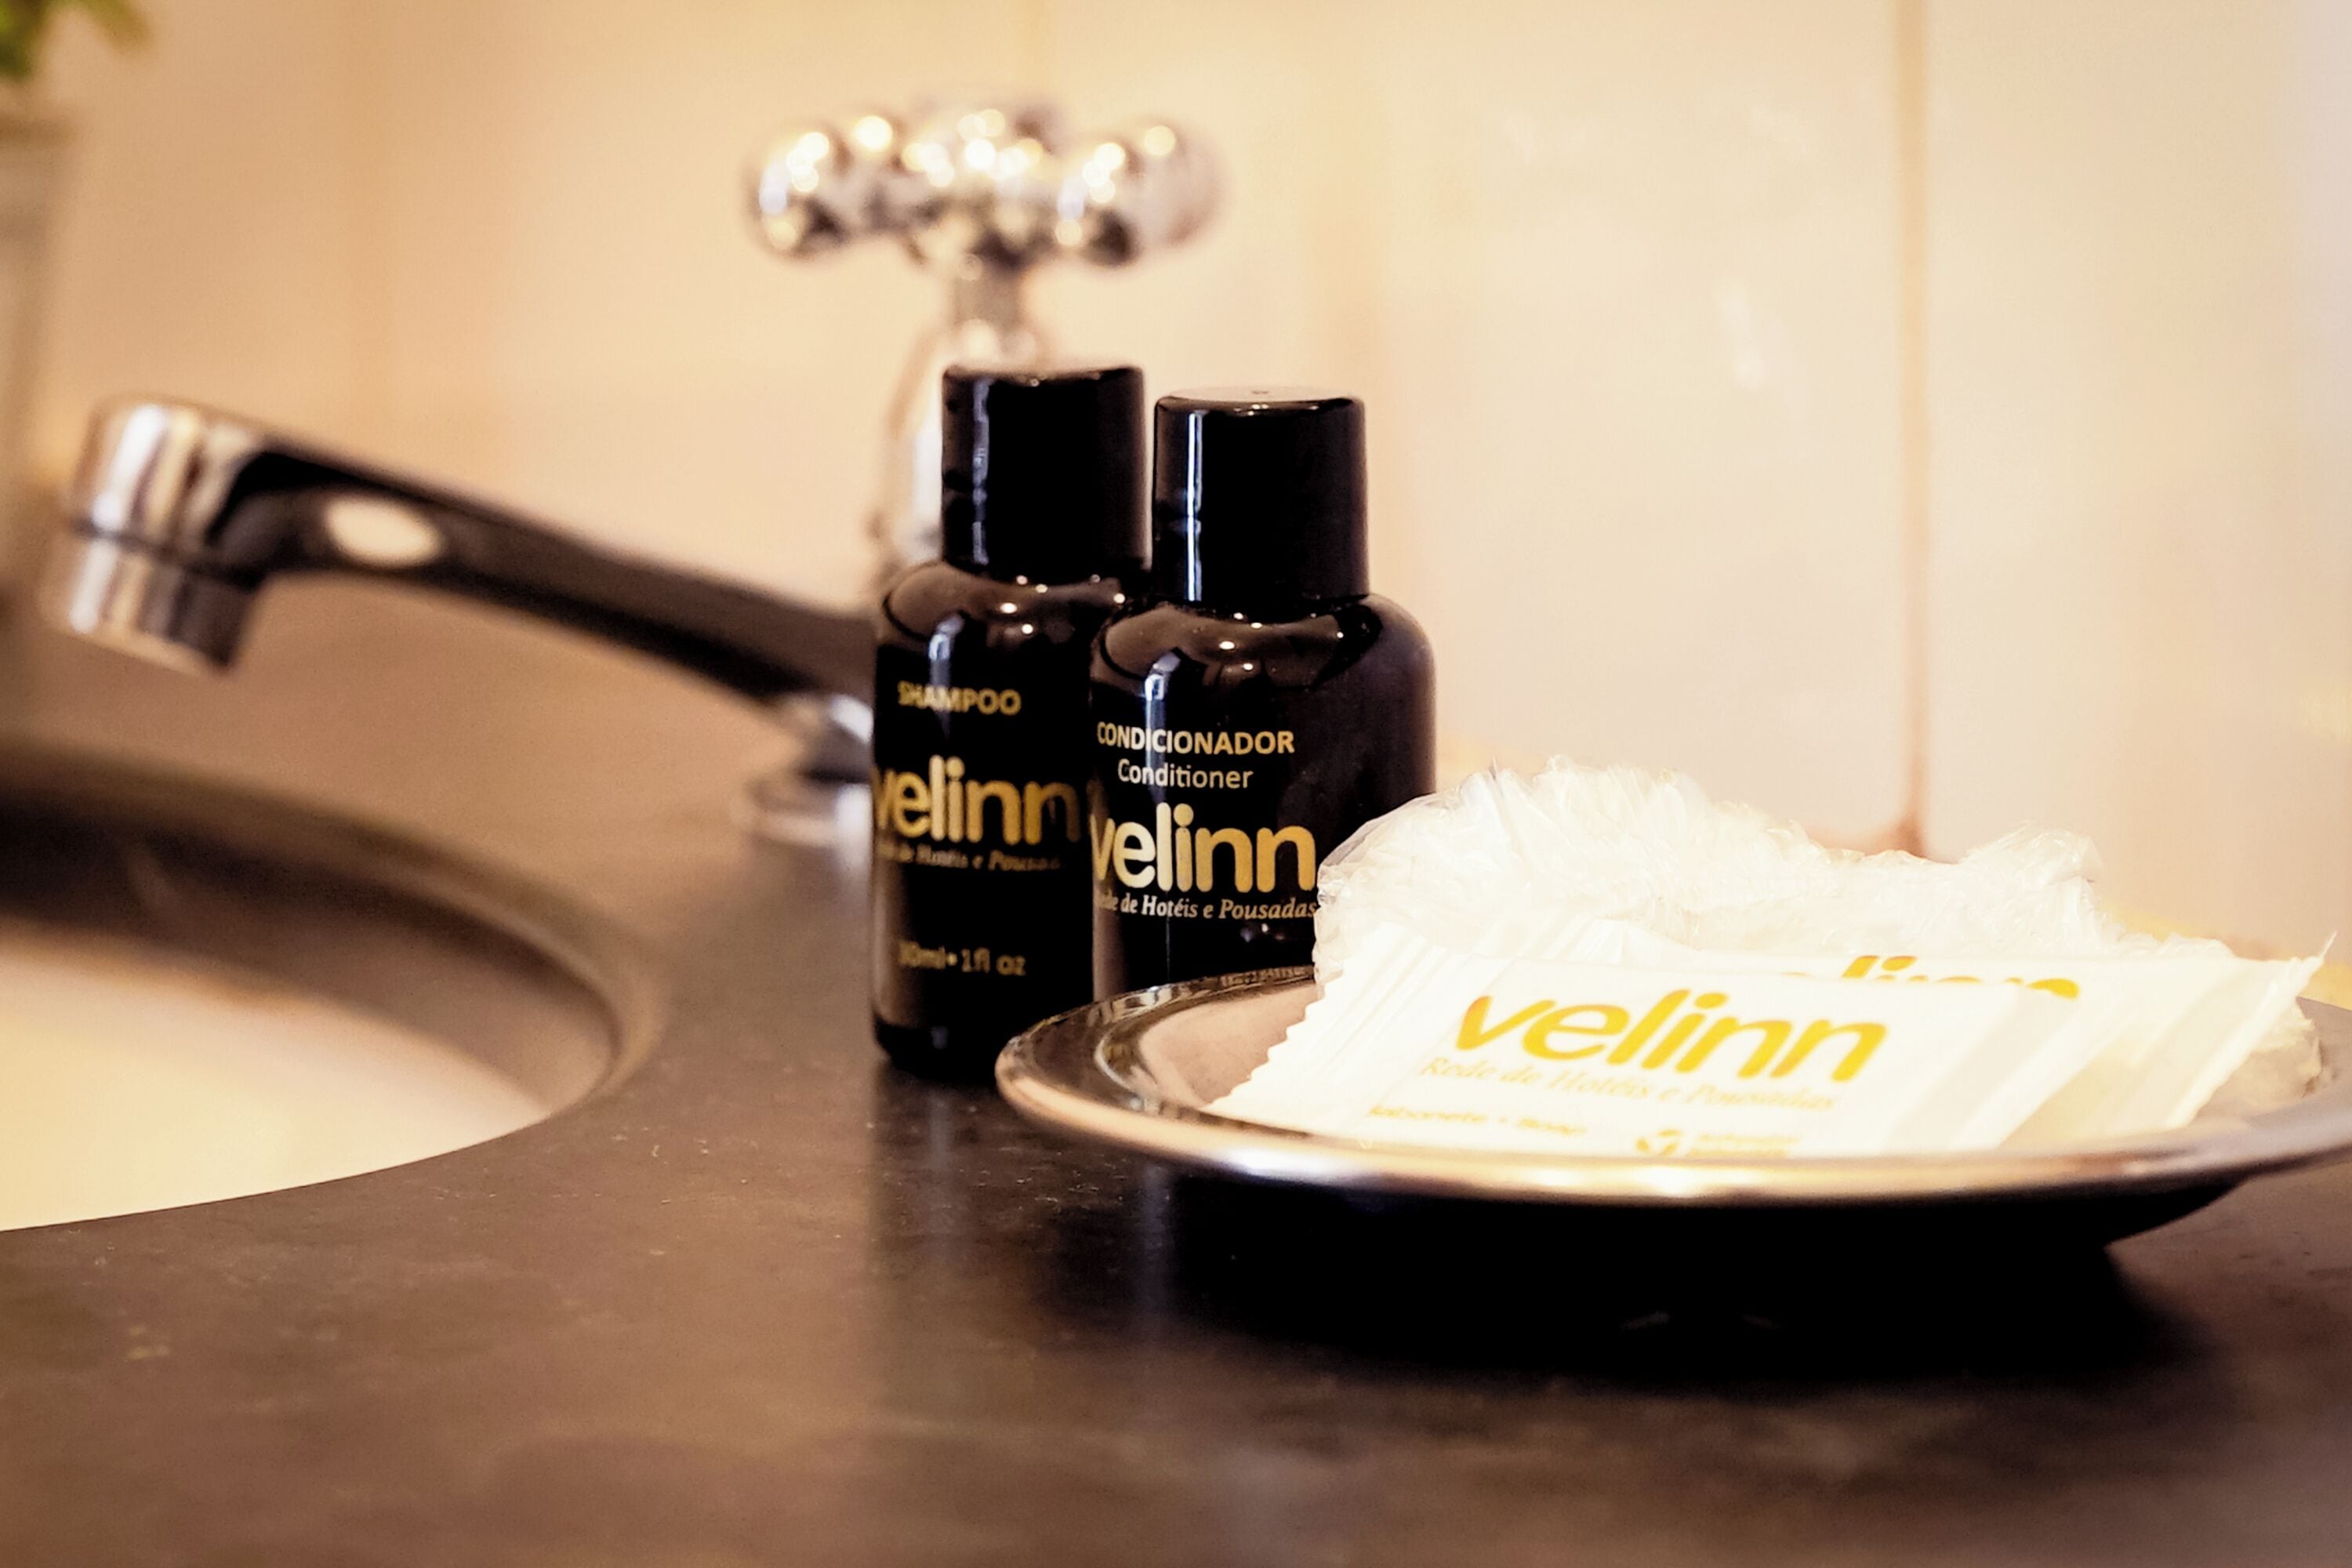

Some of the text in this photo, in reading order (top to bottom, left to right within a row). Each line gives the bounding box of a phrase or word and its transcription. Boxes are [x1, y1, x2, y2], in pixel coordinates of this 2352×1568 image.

[898, 681, 1022, 716] SHAMPOO
[1098, 721, 1295, 755] CONDICIONADOR
[1118, 758, 1254, 789] Conditioner
[870, 754, 1081, 846] velinn
[1090, 802, 1316, 893] velinn
[1120, 892, 1138, 914] de
[1141, 894, 1198, 918] Hotéis
[1203, 903, 1214, 919] e
[1218, 897, 1318, 920] Pousadas
[996, 955, 1026, 976] oz
[1456, 989, 1887, 1082] velinn
[1420, 1057, 1497, 1080] Rede
